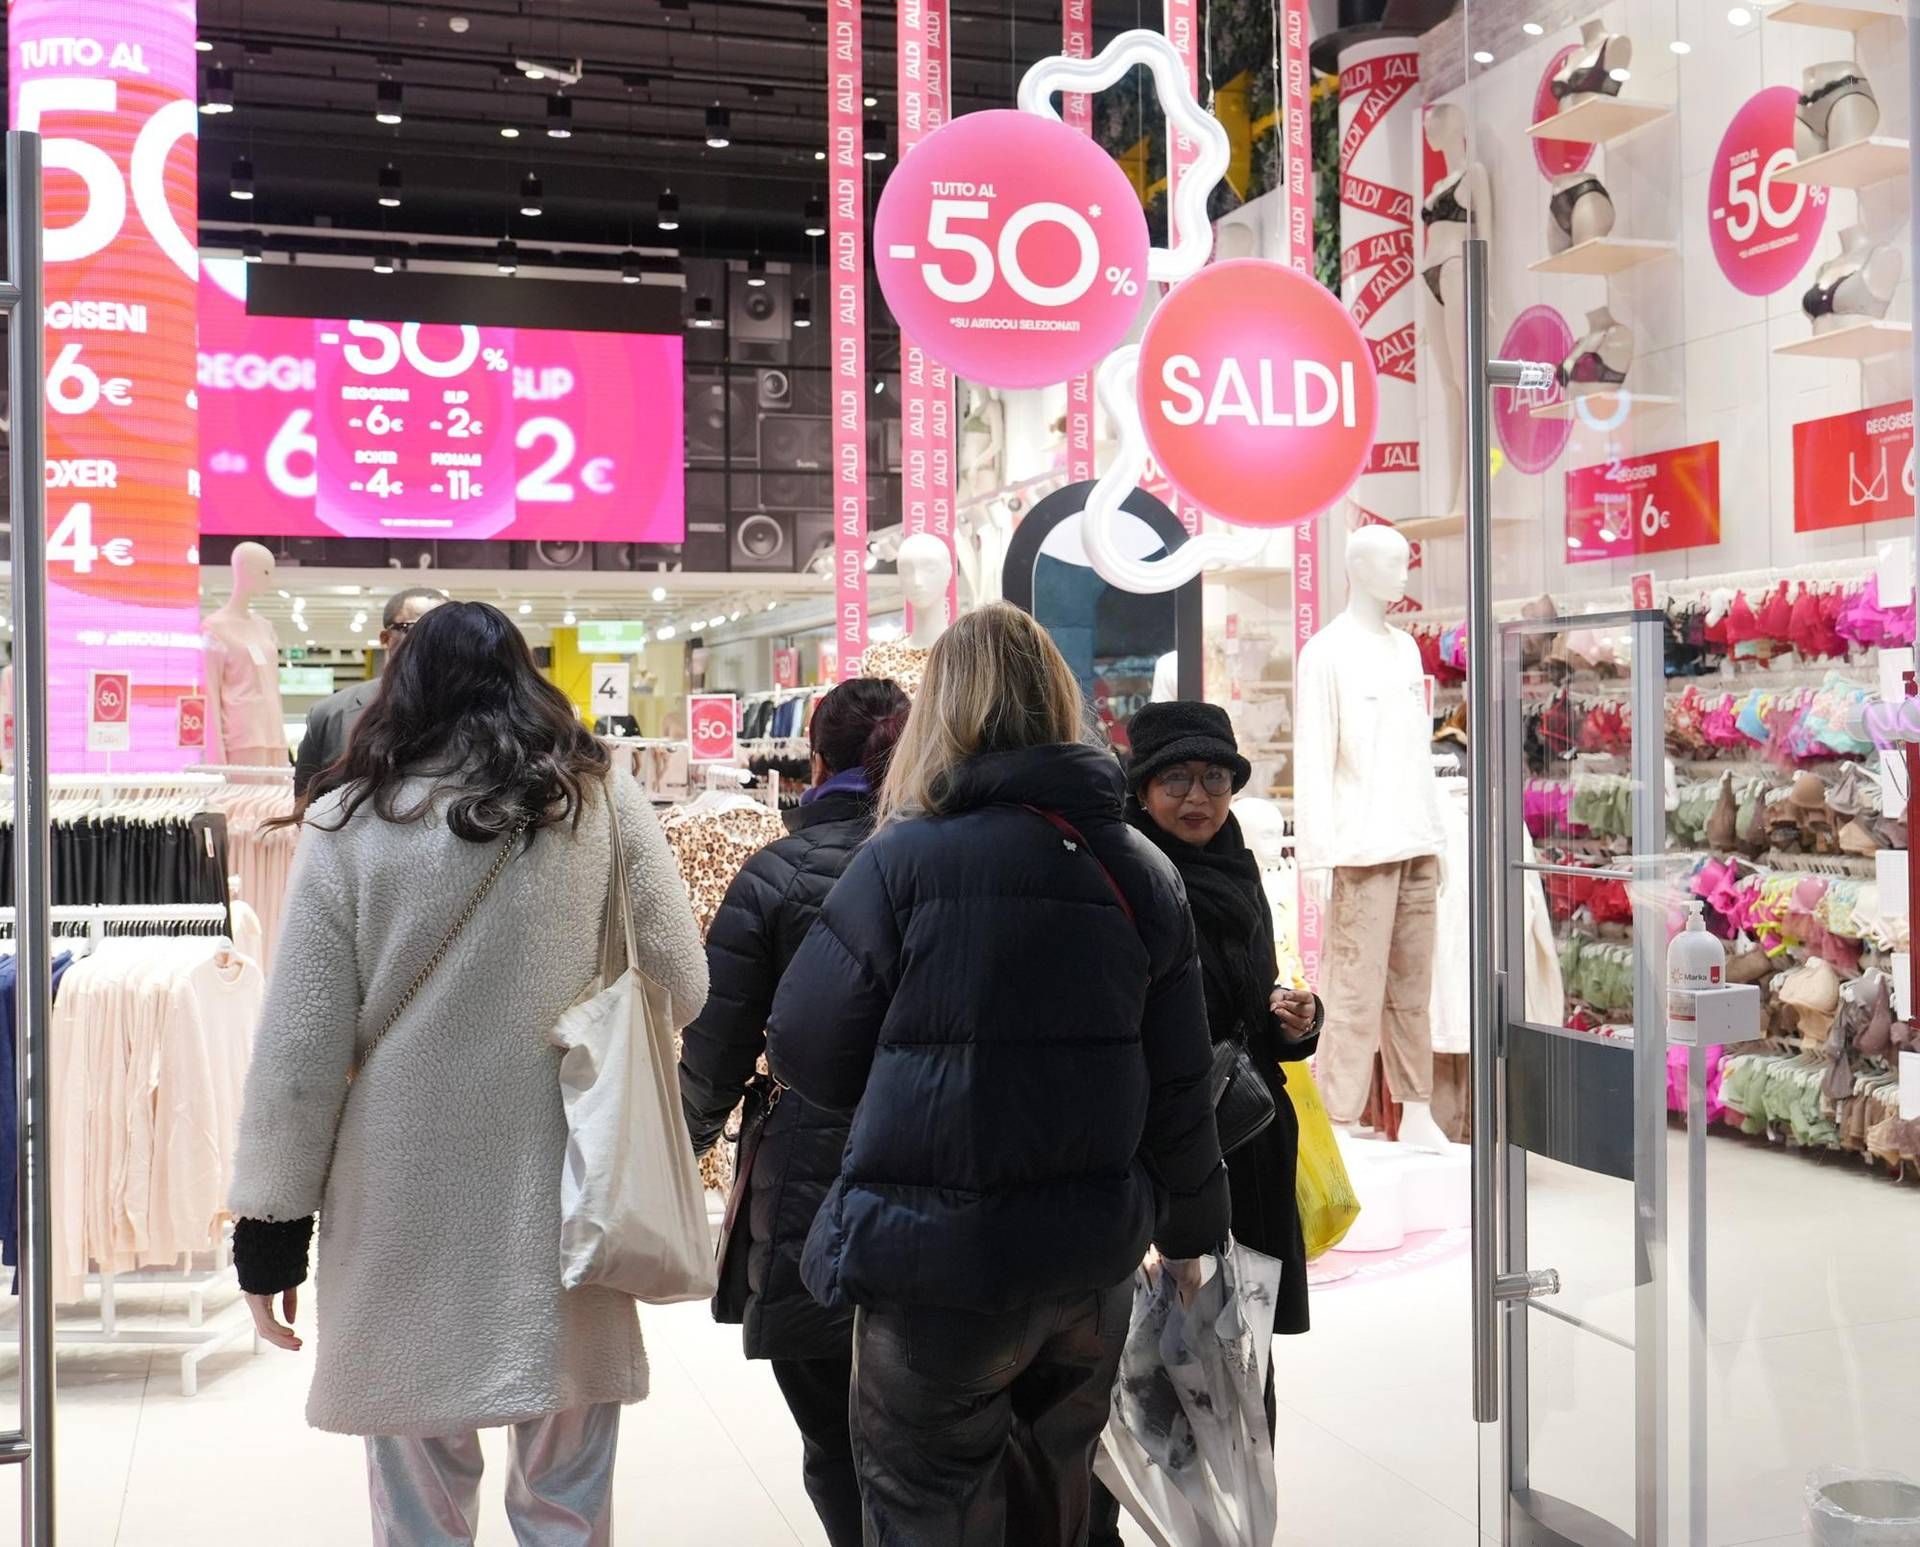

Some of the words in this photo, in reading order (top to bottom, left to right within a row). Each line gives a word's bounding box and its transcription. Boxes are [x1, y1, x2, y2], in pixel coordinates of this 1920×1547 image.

[19, 37, 103, 70] TUTTO
[109, 42, 149, 74] AL
[931, 181, 976, 197] TUTTO
[978, 183, 997, 198] AL
[43, 301, 147, 333] GISENI
[1160, 354, 1356, 428] SALDI
[598, 677, 616, 699] 4
